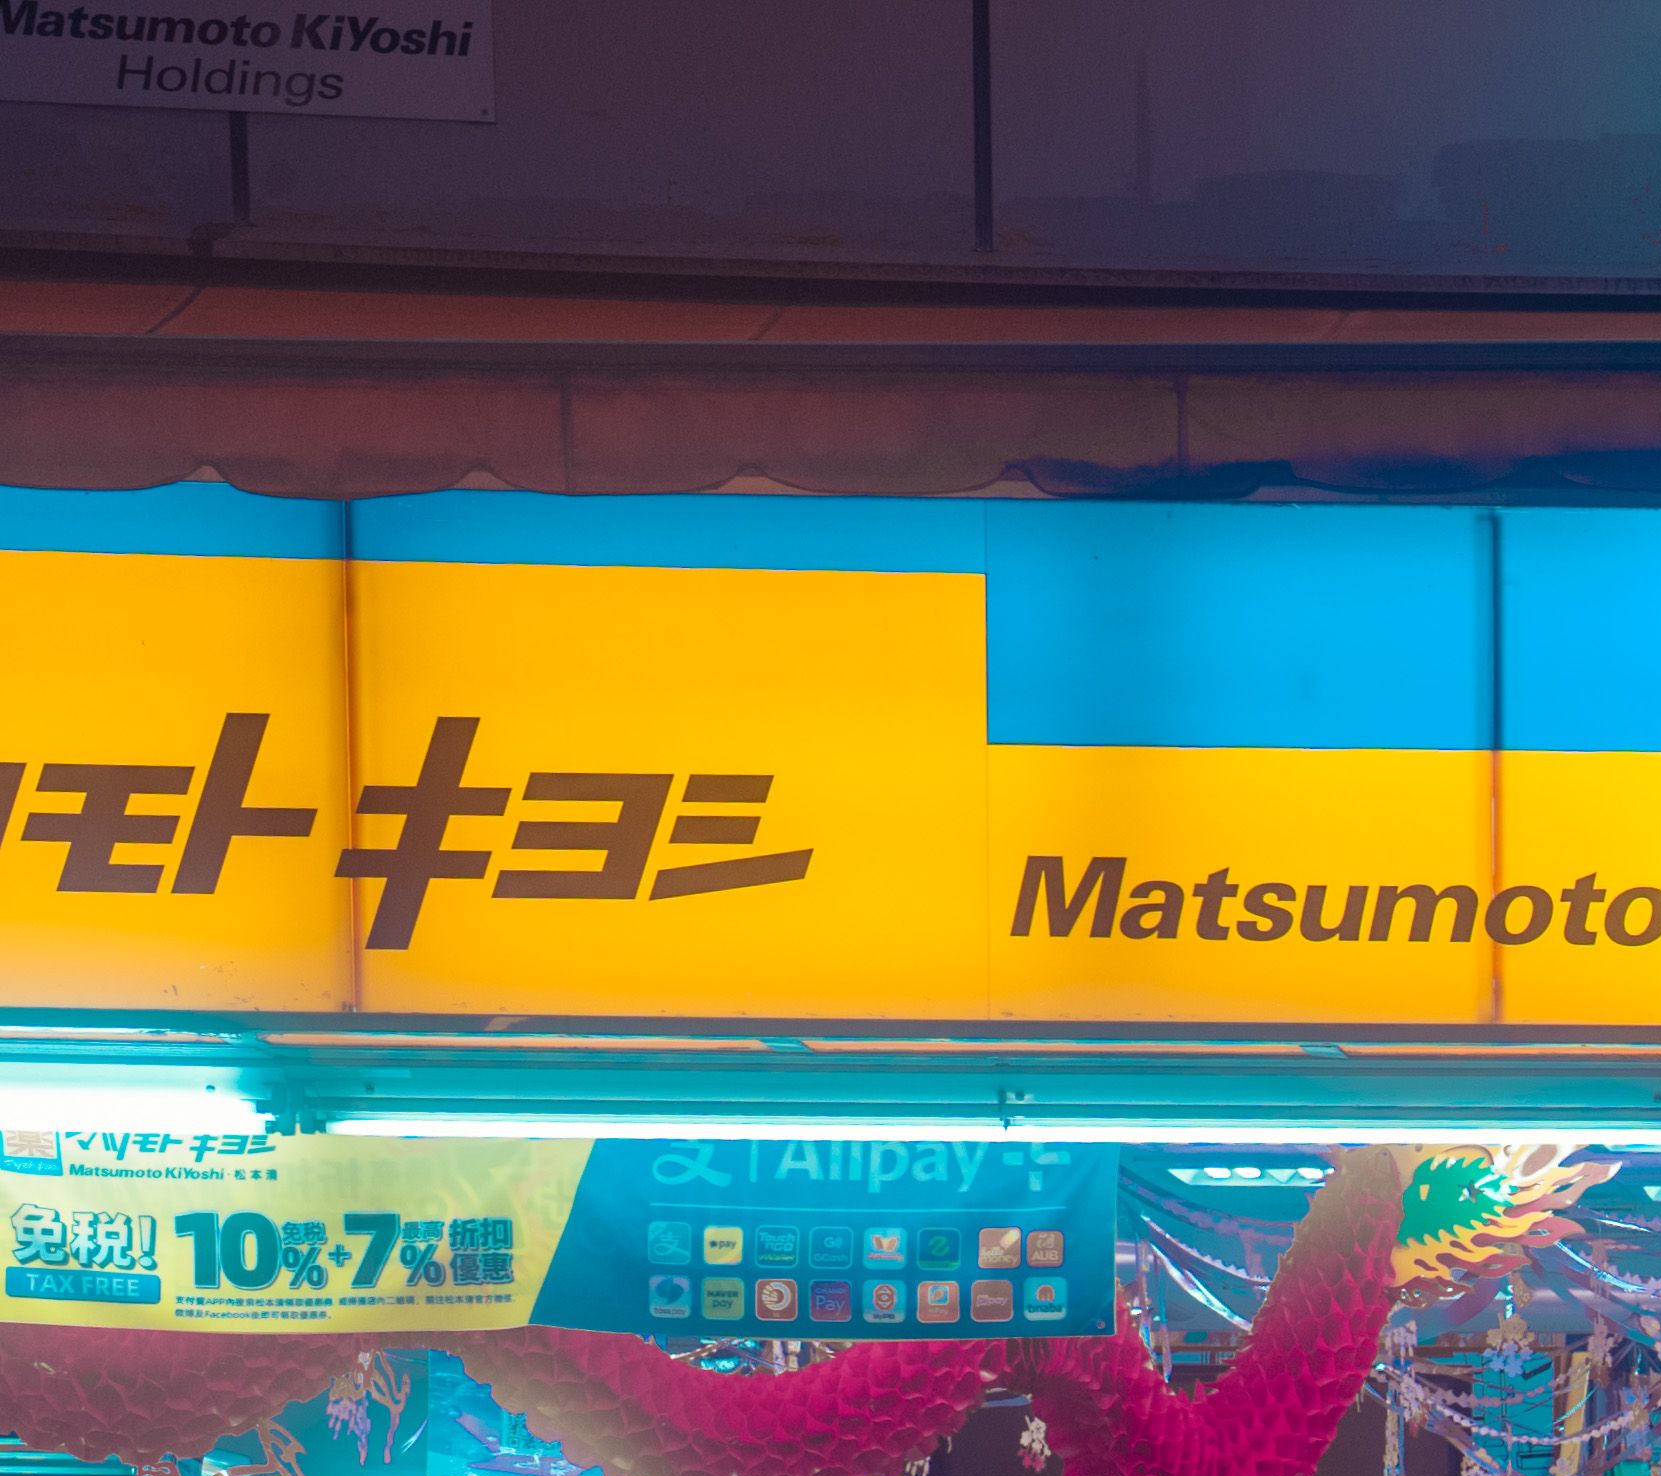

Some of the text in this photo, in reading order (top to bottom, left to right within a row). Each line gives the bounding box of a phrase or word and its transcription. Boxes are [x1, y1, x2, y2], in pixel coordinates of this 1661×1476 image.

[0, 0, 473, 58] Matsumoto KiYoshi
[115, 54, 345, 108] Holdings
[0, 712, 815, 951] モトキヨシ
[67, 1162, 163, 1180] Matsumoto
[164, 1164, 225, 1180] KiYoshi
[173, 1209, 281, 1291] 10
[342, 1210, 401, 1289] 7
[26, 1272, 142, 1298] TAX FREE
